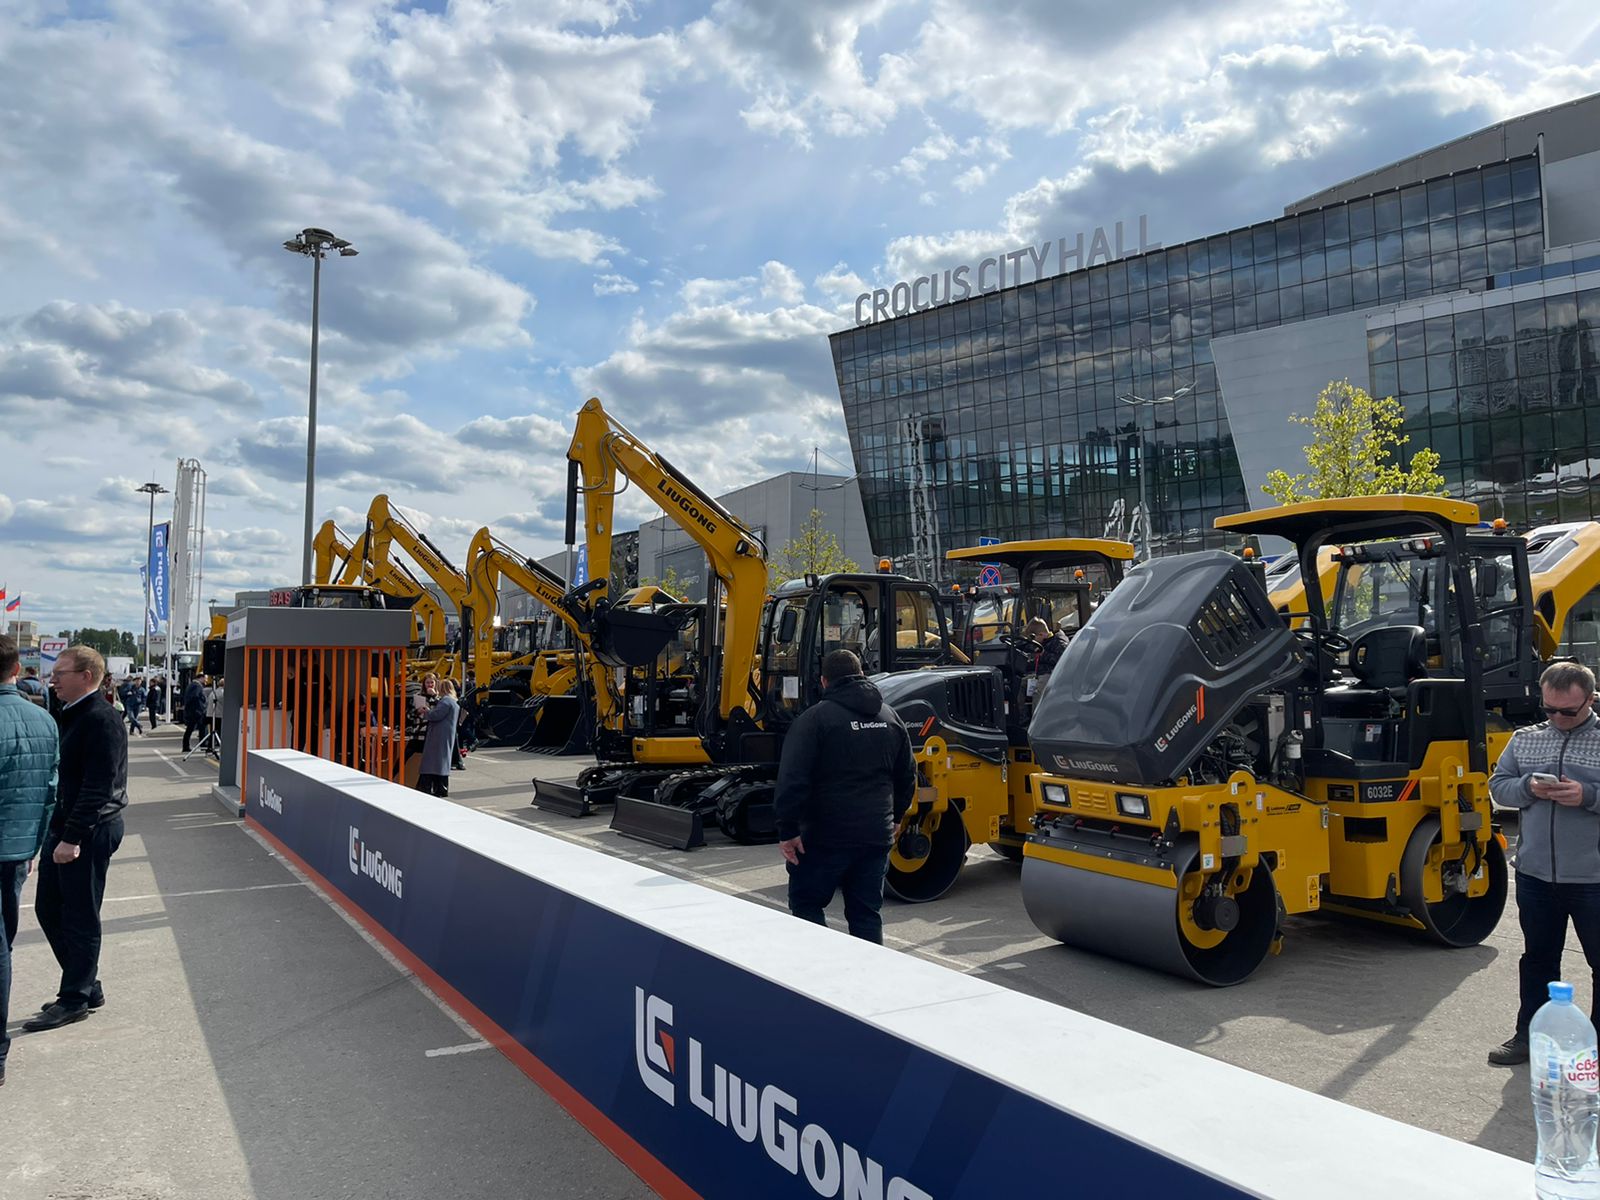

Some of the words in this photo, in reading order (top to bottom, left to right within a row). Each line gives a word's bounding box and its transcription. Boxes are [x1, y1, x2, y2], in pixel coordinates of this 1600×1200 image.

[855, 264, 972, 327] CROCUS
[978, 241, 1052, 296] CITY
[1058, 214, 1163, 274] HALL
[657, 478, 718, 535] LIUGONG
[535, 586, 570, 615] LIUGO
[1165, 704, 1198, 742] LIUGONG
[1068, 759, 1119, 773] LIUGONG
[1367, 785, 1394, 799] 6032E
[360, 841, 403, 899] LIUGONG
